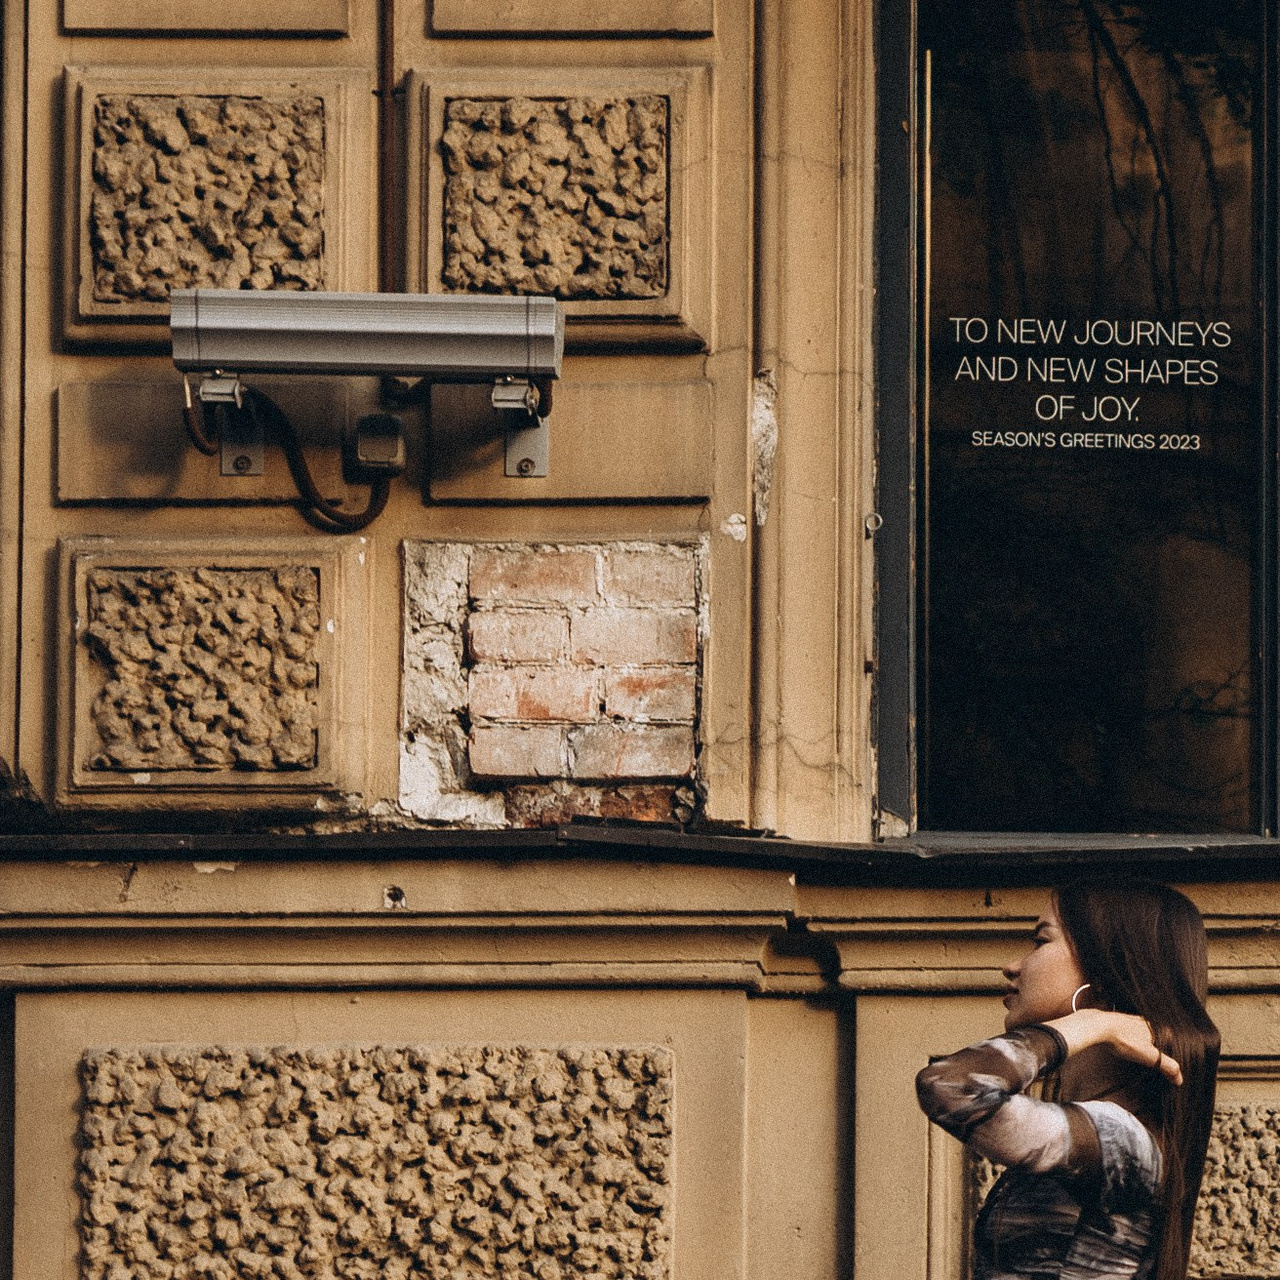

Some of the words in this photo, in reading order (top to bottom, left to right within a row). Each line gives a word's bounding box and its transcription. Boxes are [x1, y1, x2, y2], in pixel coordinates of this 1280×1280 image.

[949, 317, 988, 343] TO
[997, 318, 1066, 345] NEW
[1073, 319, 1232, 348] JOURNEYS
[954, 356, 1018, 382] AND
[1027, 357, 1097, 384] NEW
[1104, 358, 1219, 386] SHAPES
[1035, 394, 1075, 421] OF
[1081, 395, 1141, 422] JOY.
[971, 431, 1056, 448] SEASON'S
[1059, 432, 1156, 450] GREETINGS
[1158, 434, 1201, 451] 2023
